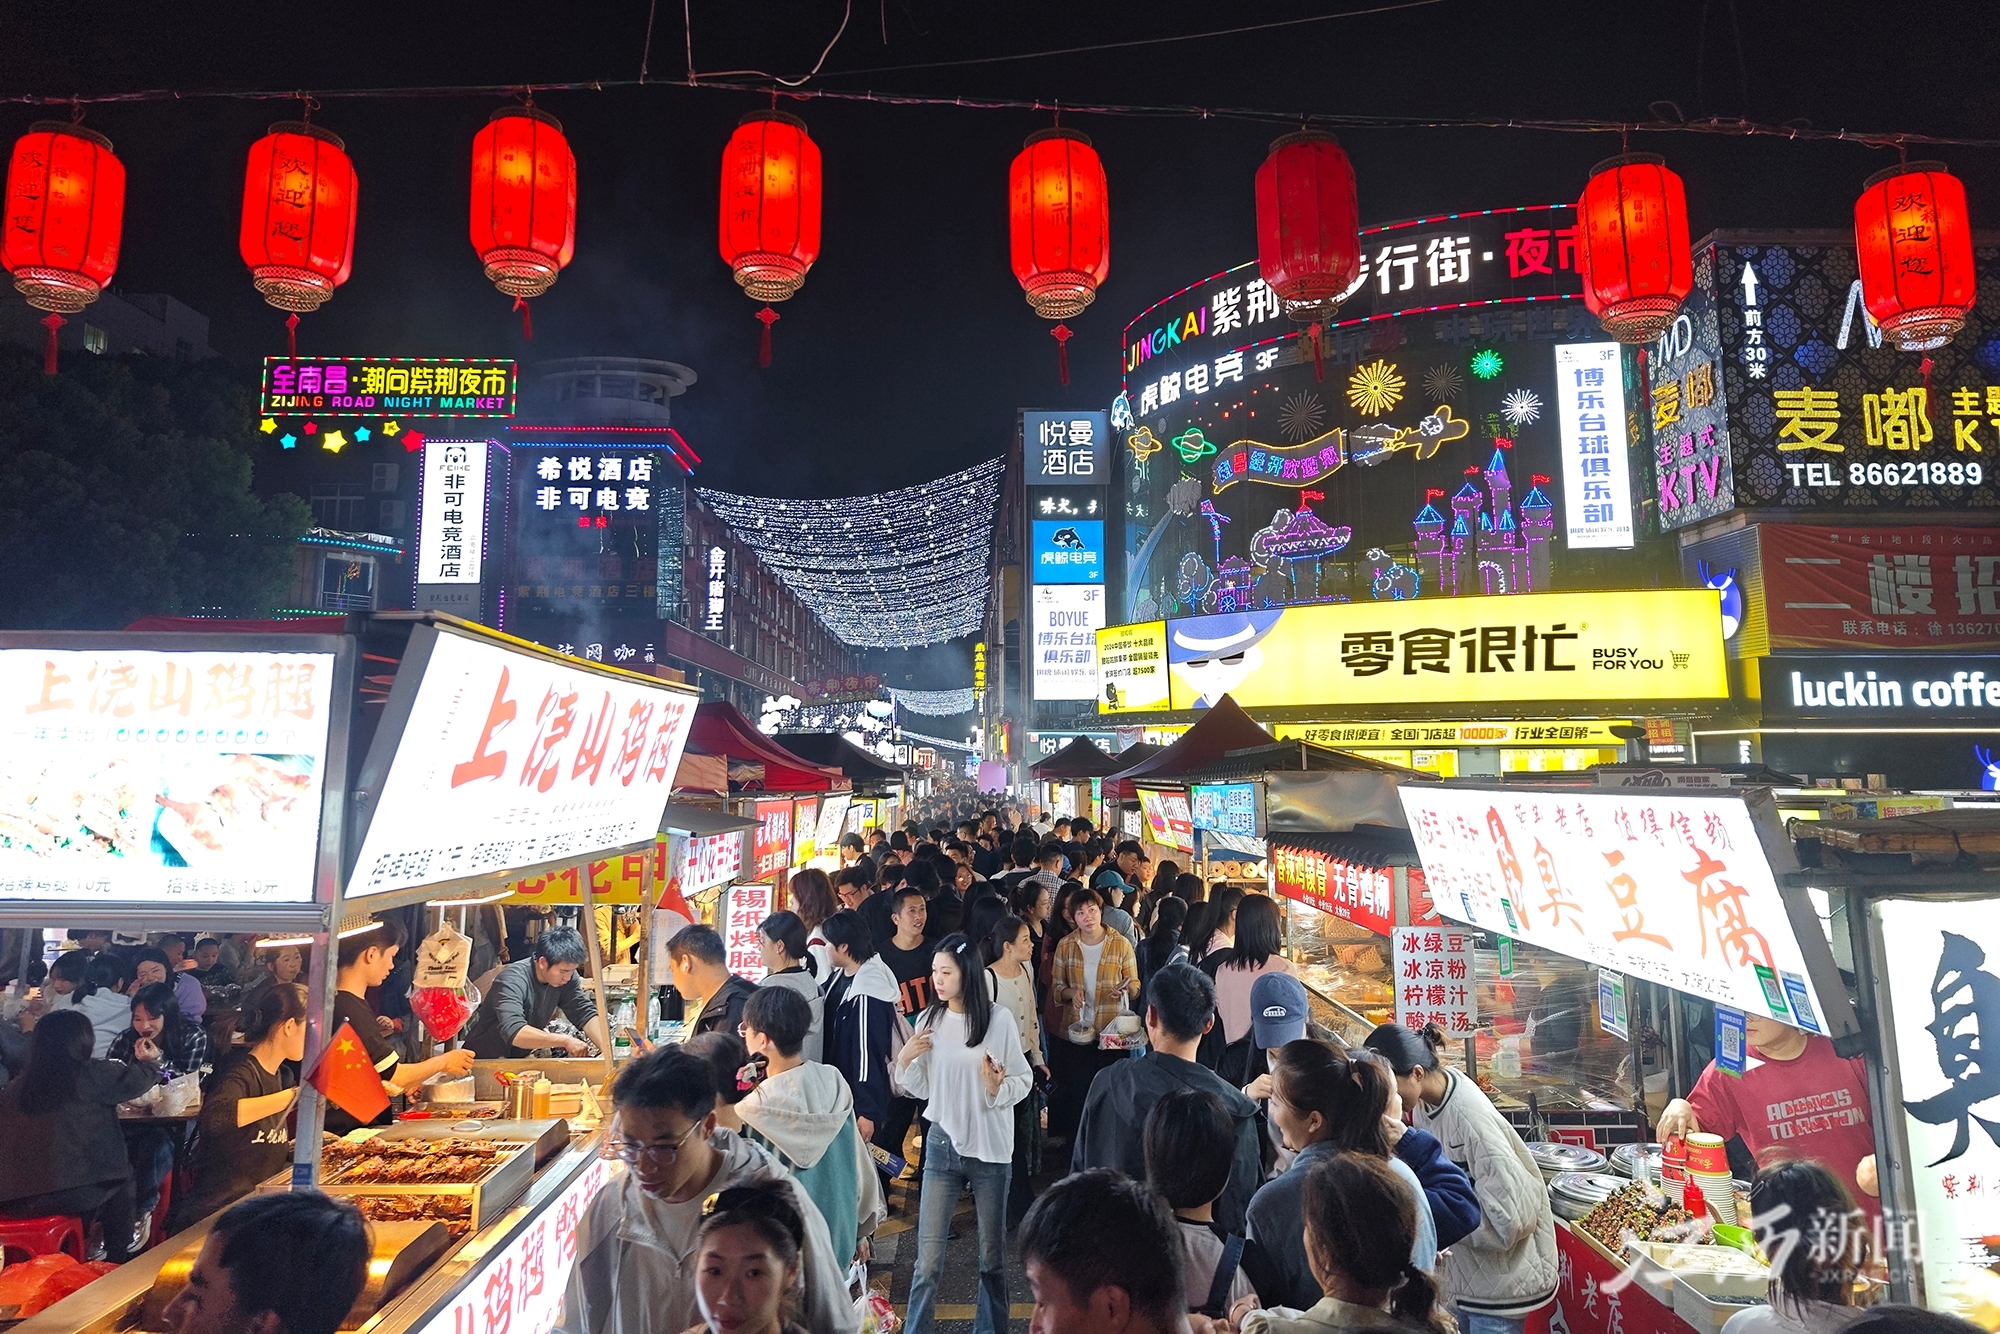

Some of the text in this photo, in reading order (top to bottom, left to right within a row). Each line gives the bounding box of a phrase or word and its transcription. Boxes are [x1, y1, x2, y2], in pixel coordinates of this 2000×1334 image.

[272, 154, 312, 241] 欢迎您
[1893, 193, 1935, 278] 欢迎您
[1126, 306, 1207, 372] JINGKAI
[1744, 308, 1767, 380] 前方30米
[1600, 349, 1615, 361] 3F
[272, 364, 507, 396] 全南昌·潮向紫荆夜市
[1141, 346, 1279, 417] 虎鲸电竞 3F
[271, 395, 505, 409] ZIJING ROAD NIGHT MARKET
[1653, 363, 1714, 430] 麦嘟
[1773, 386, 1933, 453] 麦嘟
[1039, 420, 1095, 447] 悦曼
[1573, 367, 1614, 523] 博乐台球俱乐部
[1660, 423, 1715, 467] 主题式
[536, 456, 653, 482] 希悦酒店
[1040, 449, 1095, 476] 酒店
[1786, 461, 1983, 487] TEL 86621889
[1660, 455, 1719, 513] KTV
[536, 486, 651, 511] 非可电竞
[439, 474, 465, 578] 非可电竞酒店
[1040, 551, 1097, 565] 虎鲸电竞
[1088, 571, 1099, 579] 3F
[1083, 589, 1100, 601] 3F
[1049, 611, 1089, 627] BOYUE
[1044, 649, 1091, 664] 俱乐部
[1341, 624, 1579, 677] 零食很忙
[1593, 648, 1638, 660] BUSY
[1593, 659, 1664, 670] FOR YOU
[807, 675, 880, 696] 紫荆夜市
[1791, 671, 1903, 707] luckin
[1391, 728, 1456, 741] 全国门店超
[1459, 726, 1508, 740] 10000家
[1515, 725, 1604, 740] 行业全国第一
[1614, 806, 1735, 852] 值得信赖
[243, 878, 279, 895] 10元
[1332, 862, 1390, 920] 无骨鸡柳
[1534, 835, 1780, 988] 臭豆腐
[1402, 932, 1467, 954] 冰绿豆
[1403, 958, 1467, 981] 冰凉粉
[1404, 984, 1469, 1007] 柠檬汁
[1264, 1008, 1286, 1017] emis
[1405, 1011, 1470, 1033] 酸梅汤
